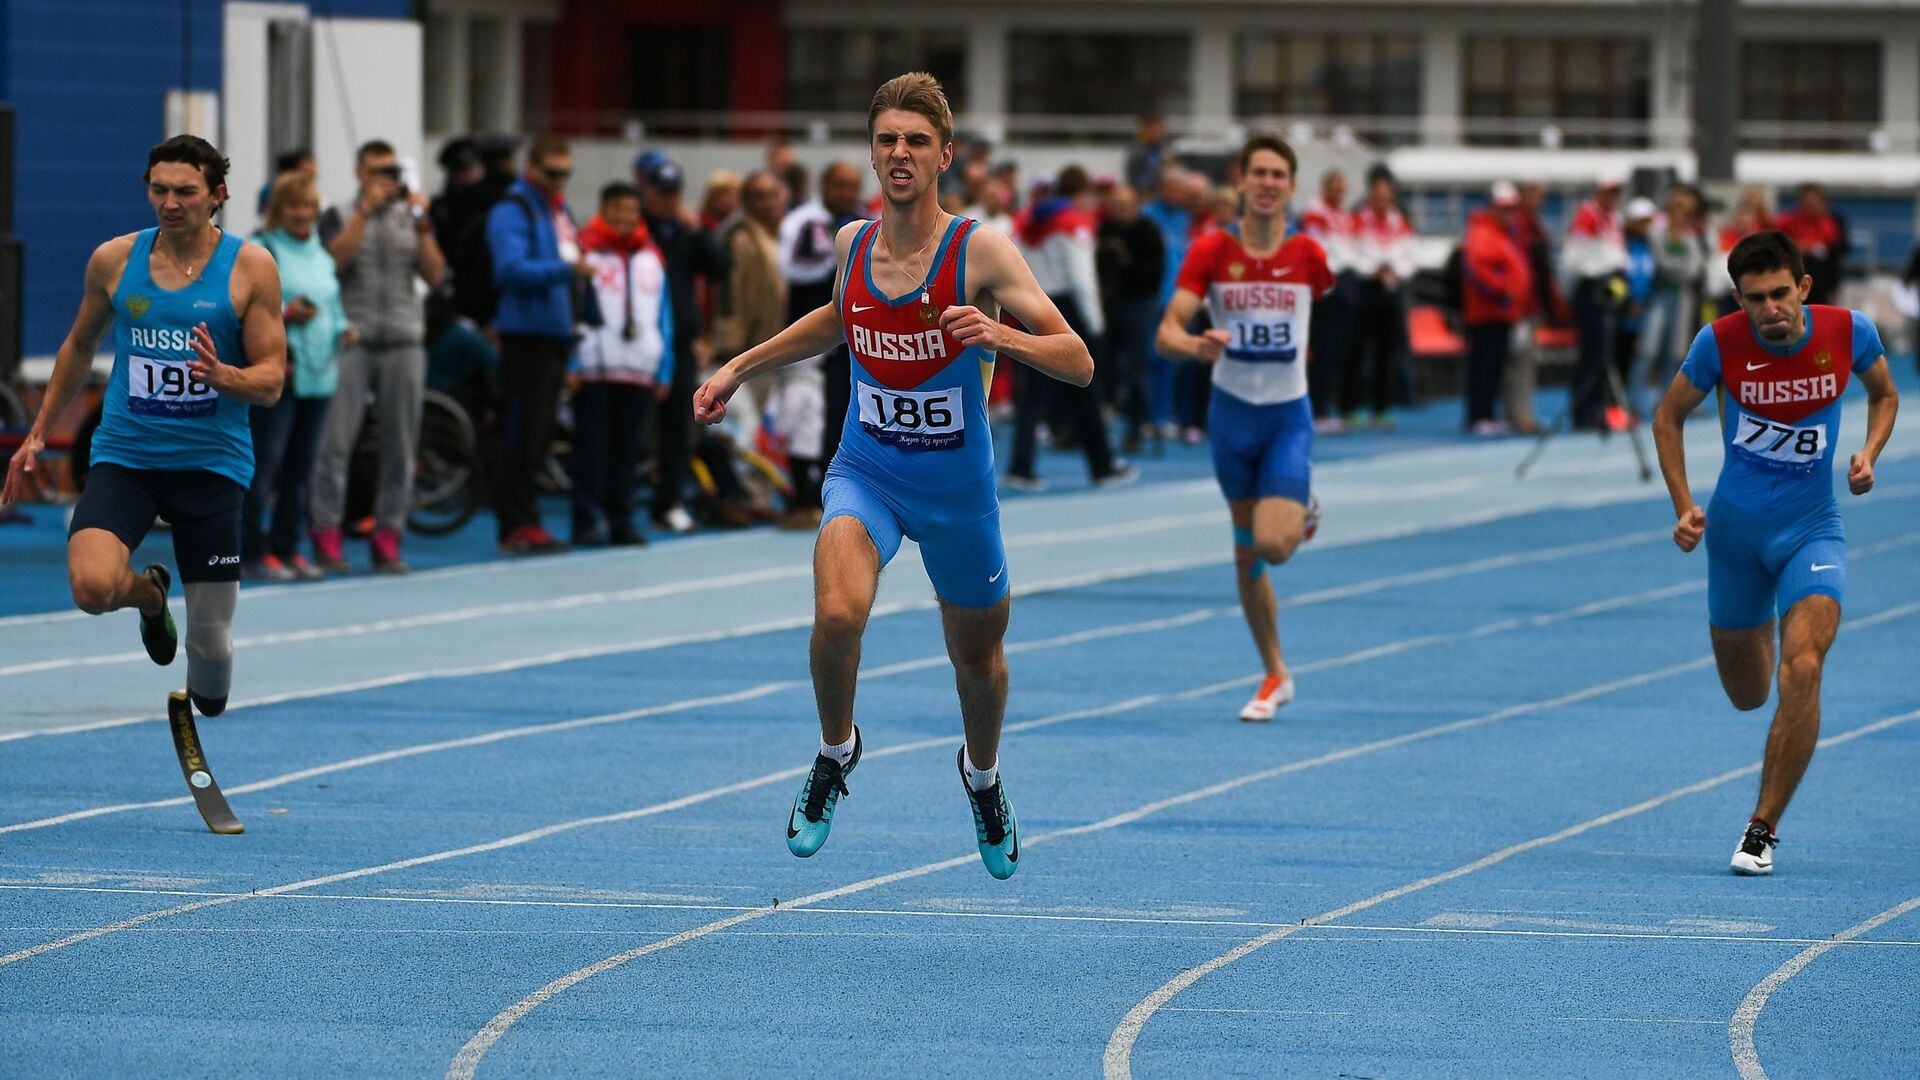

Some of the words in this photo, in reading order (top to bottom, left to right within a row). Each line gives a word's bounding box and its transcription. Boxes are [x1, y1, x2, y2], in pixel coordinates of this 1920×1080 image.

[1223, 285, 1297, 315] RUSSIA
[852, 323, 947, 361] RUSSIA
[1238, 322, 1292, 347] 183
[144, 364, 211, 396] 198
[1740, 373, 1837, 405] RUSSIA
[871, 393, 952, 429] 186
[1743, 417, 1819, 455] 778
